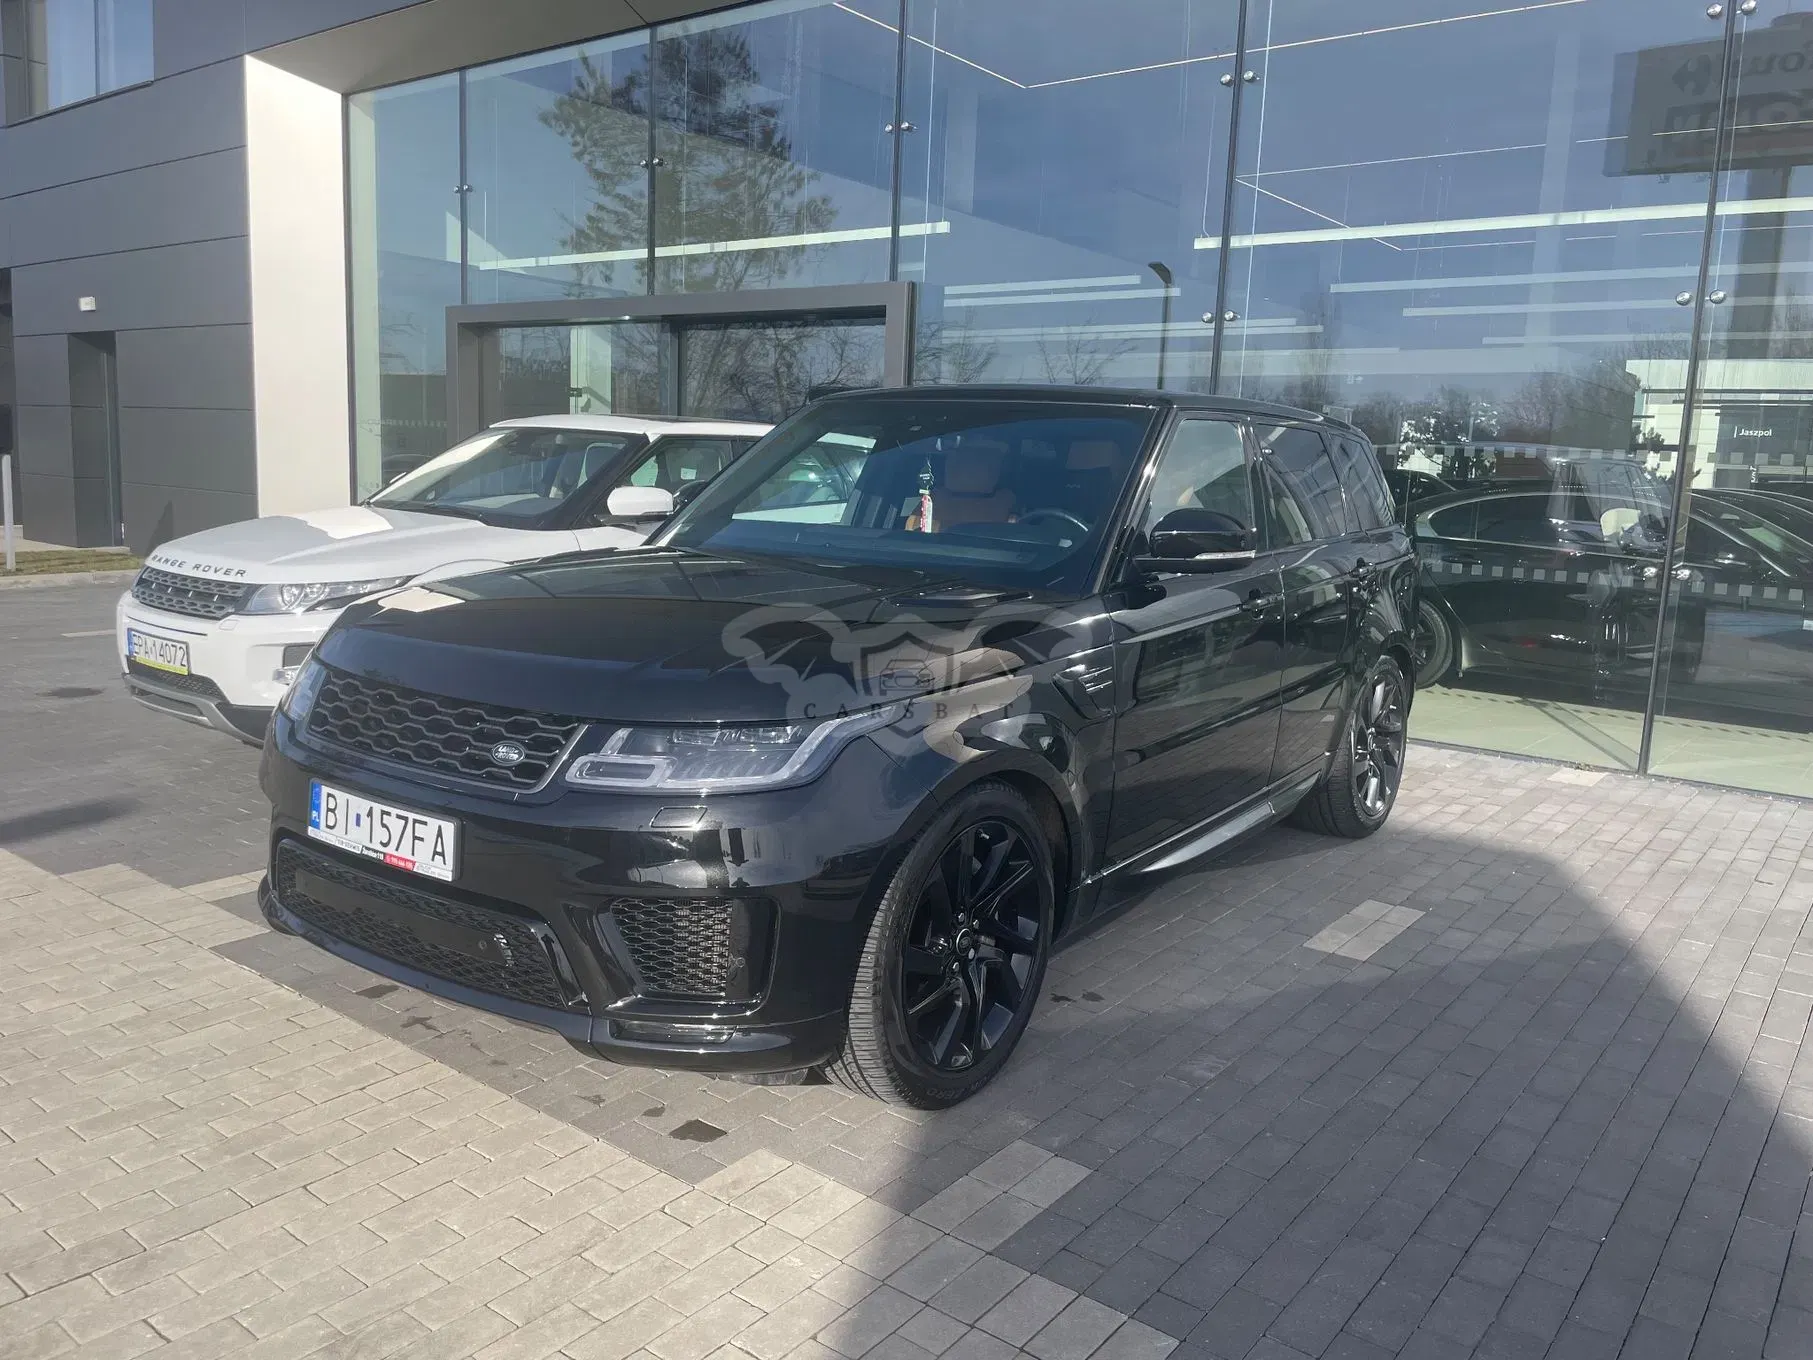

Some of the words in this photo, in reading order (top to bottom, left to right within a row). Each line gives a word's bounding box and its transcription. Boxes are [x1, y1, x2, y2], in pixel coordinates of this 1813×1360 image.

[1739, 428, 1772, 437] Jaszpol
[151, 554, 187, 568] RANGE
[191, 563, 247, 577] ROVER
[152, 638, 186, 667] 14072
[366, 806, 447, 866] 157FA
